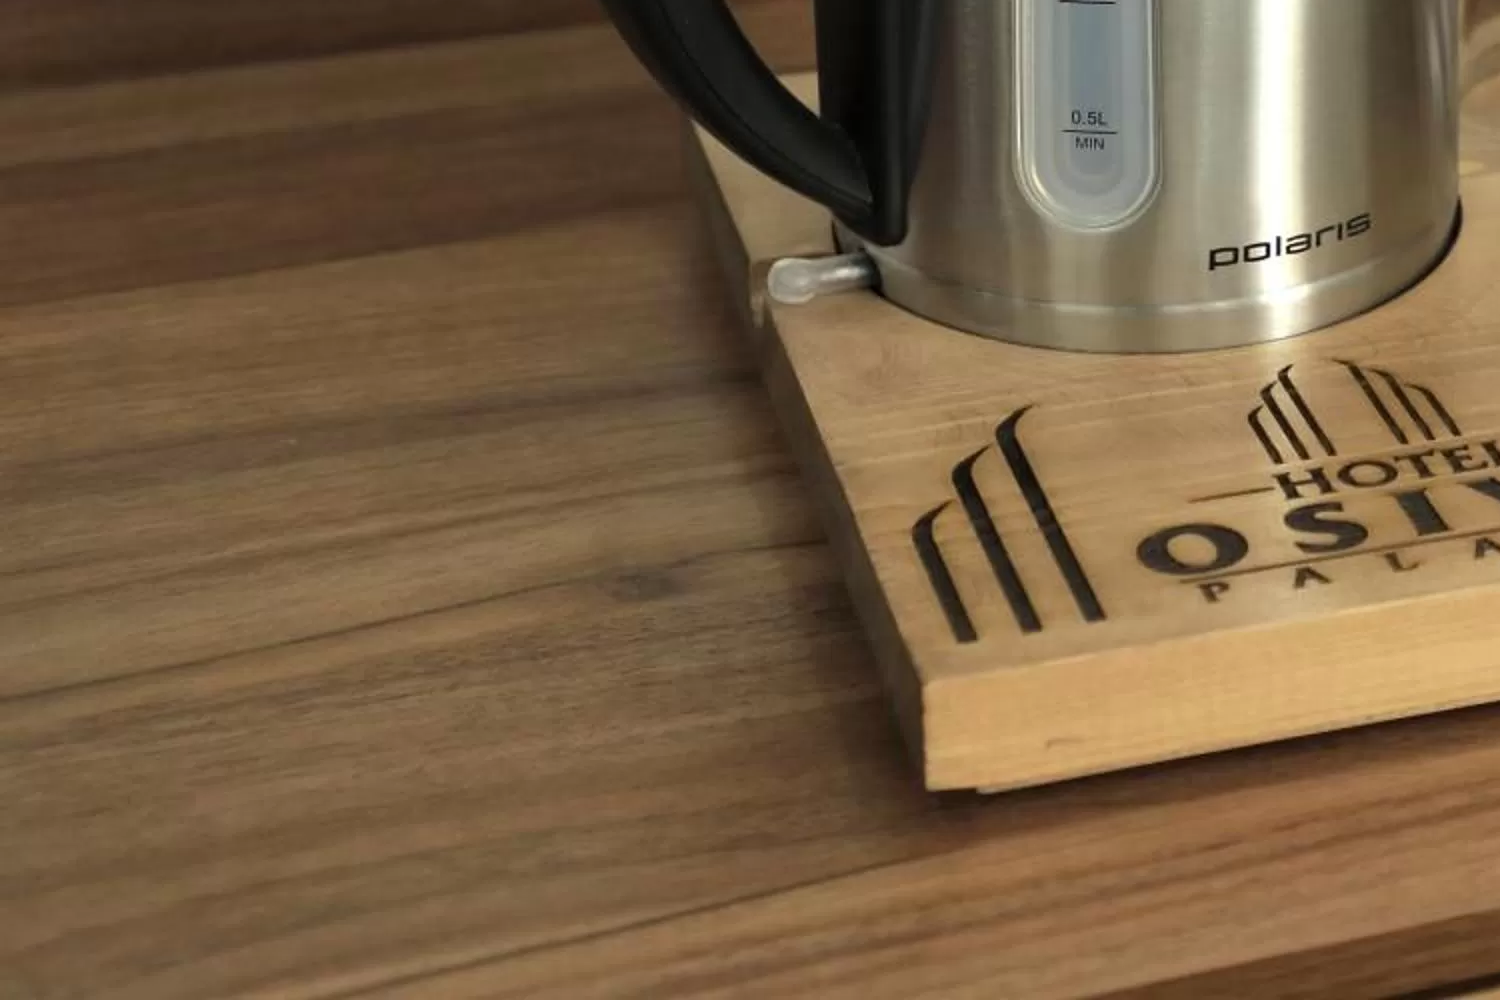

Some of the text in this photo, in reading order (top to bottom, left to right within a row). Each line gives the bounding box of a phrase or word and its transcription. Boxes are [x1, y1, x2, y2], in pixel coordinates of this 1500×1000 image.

[1071, 110, 1108, 126] 0.5L
[1075, 137, 1105, 150] MIN
[1208, 212, 1371, 271] polaris
